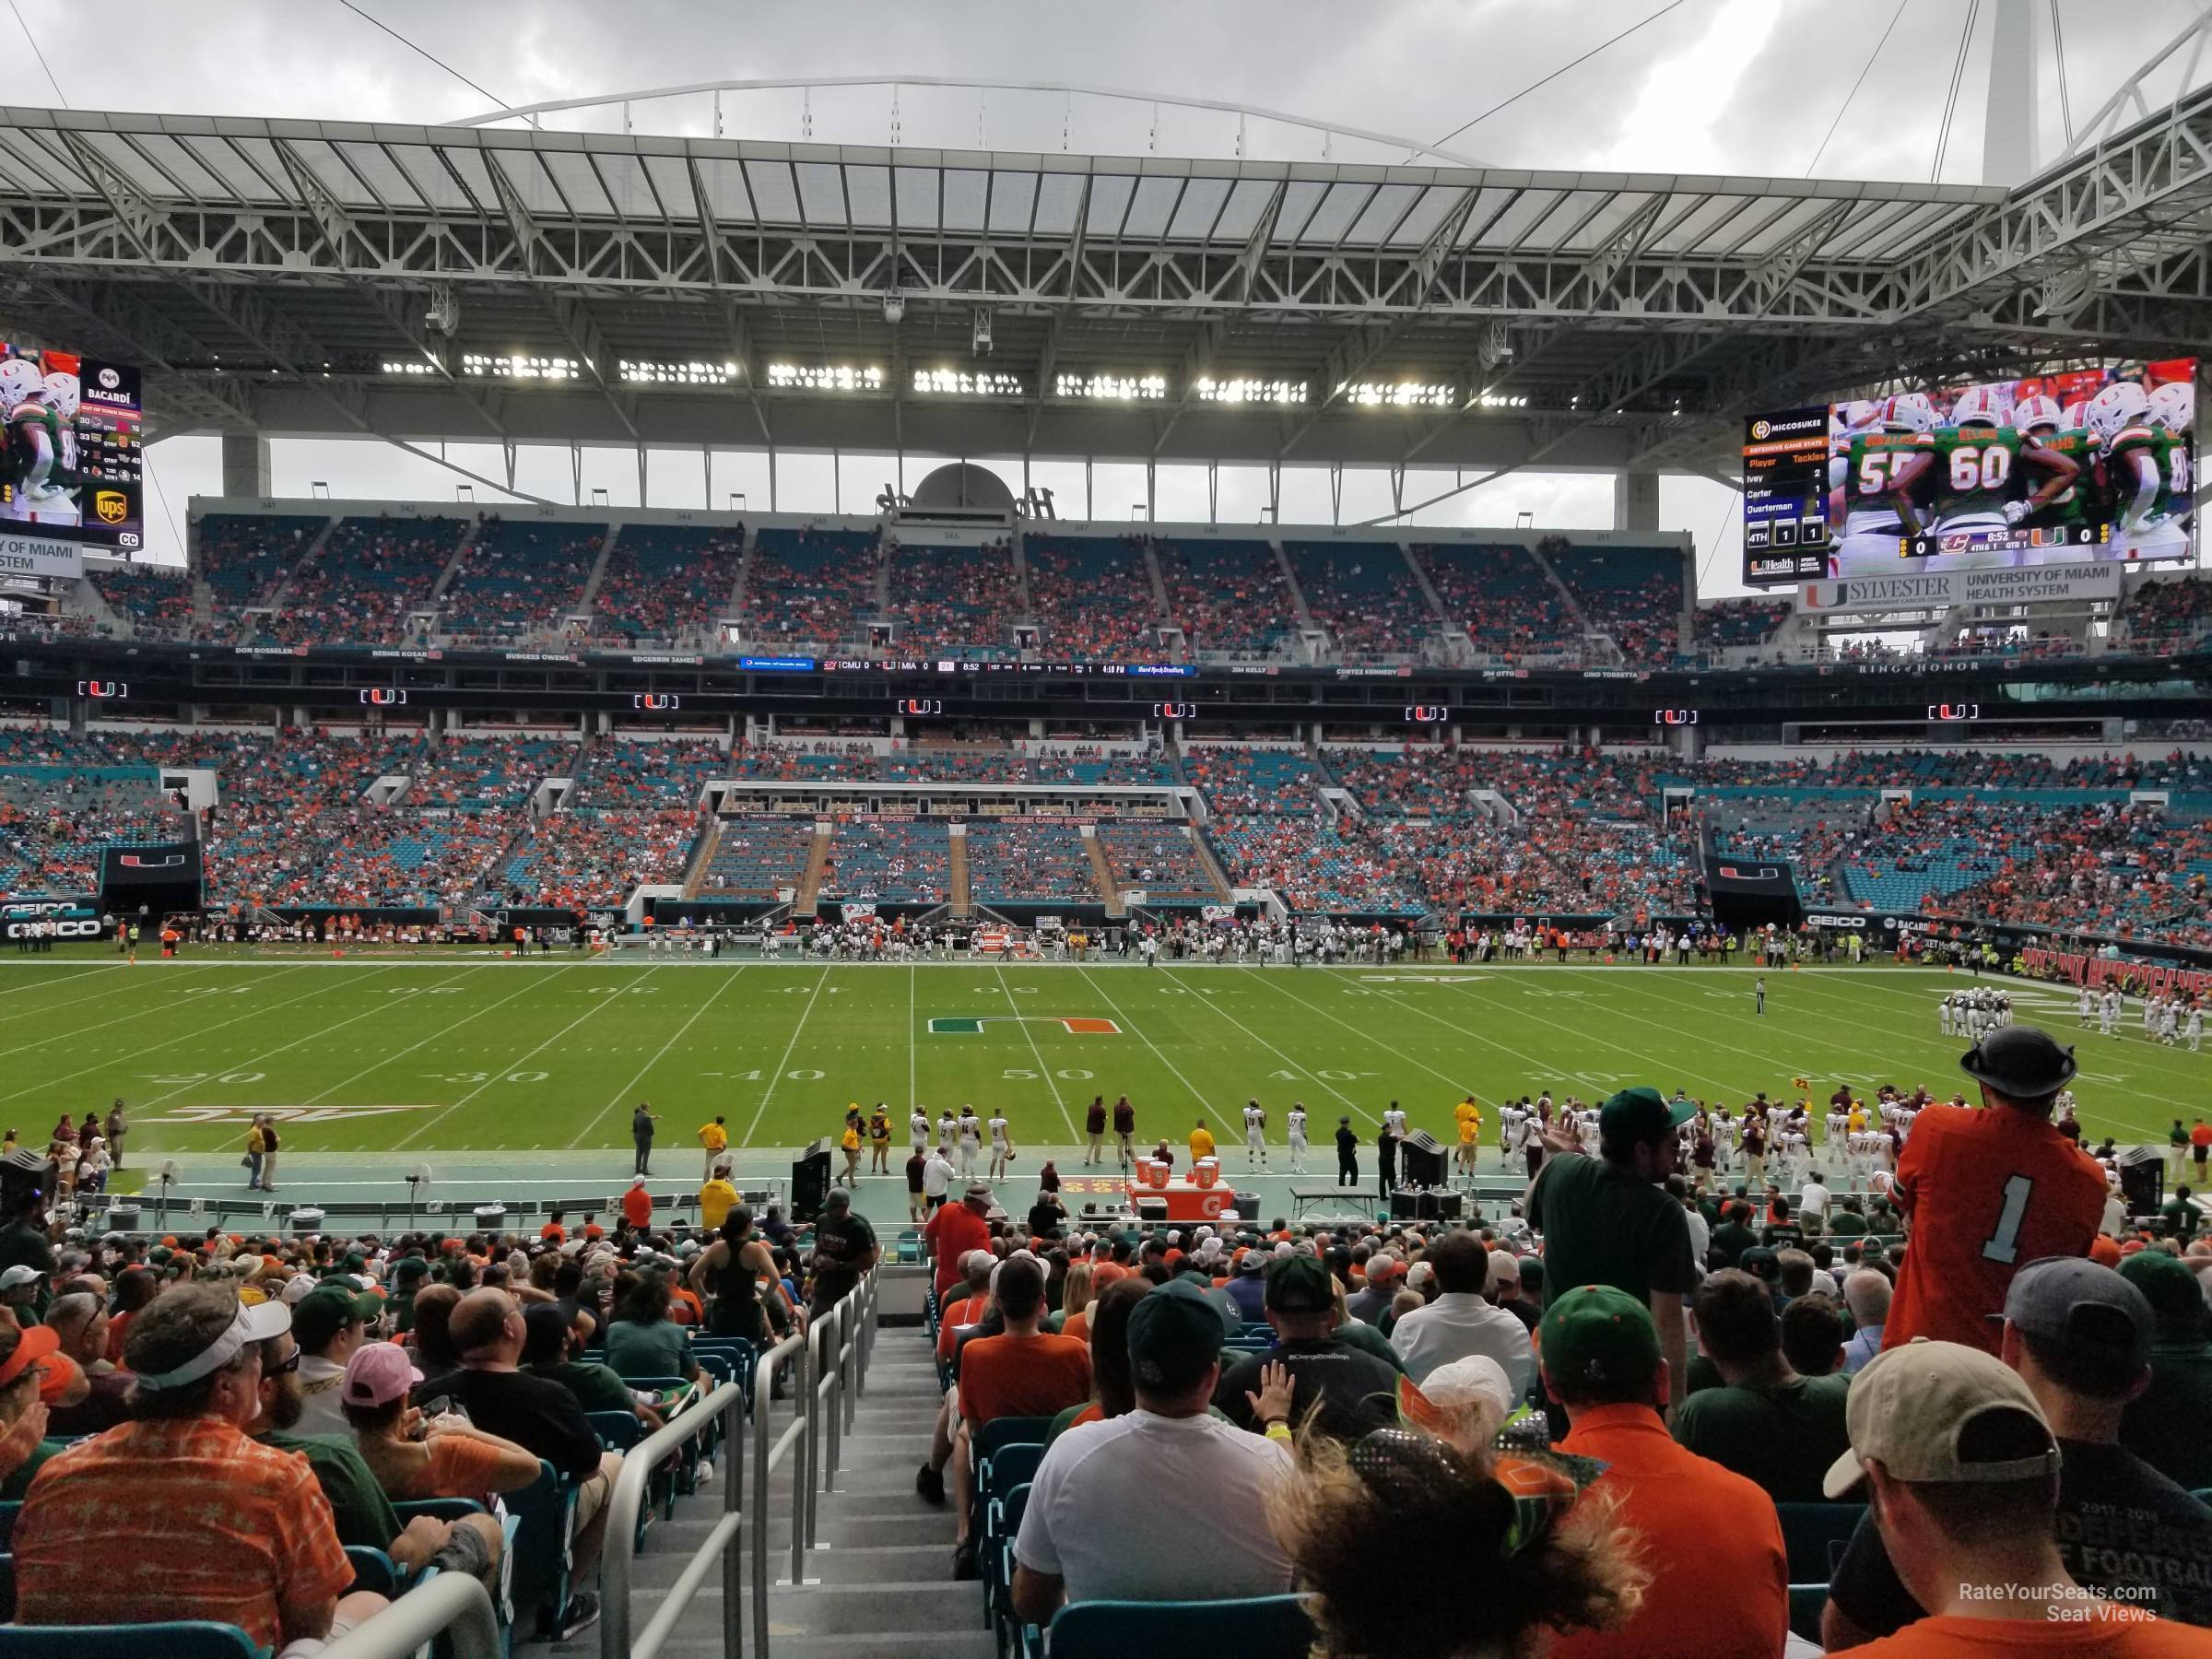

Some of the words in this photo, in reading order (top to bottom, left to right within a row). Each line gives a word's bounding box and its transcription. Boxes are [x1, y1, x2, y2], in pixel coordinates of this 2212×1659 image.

[88, 389, 131, 404] BACARDÍ
[79, 417, 89, 425] 30
[1771, 419, 1821, 431] MICCOSUKEE
[79, 432, 89, 441] 33
[1749, 443, 1783, 453] DEFENSIVE
[1784, 441, 1803, 450] GAME
[1749, 459, 1776, 468] Player
[1793, 453, 1825, 463] Tackles
[1950, 446, 2010, 490] 60
[1747, 475, 1763, 483] Ivey
[1814, 468, 1820, 477] 2
[1747, 489, 1772, 499] Carter
[100, 500, 124, 518] ups
[1747, 503, 1793, 513] Quarterman
[1749, 533, 1768, 543] 4TH
[1783, 531, 1788, 540] 1
[1810, 528, 1816, 538] 1
[1987, 531, 2009, 542] 8:52
[2080, 529, 2091, 542] 0
[122, 535, 136, 545] CC
[8, 541, 26, 553] OF
[29, 543, 73, 558] MIAMI
[1916, 542, 1925, 554] 0
[1967, 571, 2042, 586] UNIVERSITY
[2045, 570, 2063, 582] OF
[2065, 567, 2109, 581] MIAMI
[1850, 577, 1950, 599] SYLVESTER
[1967, 585, 2014, 599] HEALTH
[2018, 583, 2069, 596] SYSTEM
[841, 661, 861, 669] CMU
[864, 661, 869, 669] 0
[901, 662, 916, 670] MIA
[923, 662, 928, 670] 0
[963, 662, 979, 671] 8:52
[1859, 664, 1900, 674] RING
[1917, 662, 1979, 673] HONOR
[1807, 915, 1865, 927] GEICO
[1898, 920, 1929, 932] BACARD
[731, 1069, 827, 1081] 40
[1002, 1069, 1095, 1080] 50
[1795, 1079, 1808, 1089] 23
[1201, 1195, 1221, 1217] G
[1982, 1174, 2034, 1264] 1
[2180, 1212, 2187, 1228] 1
